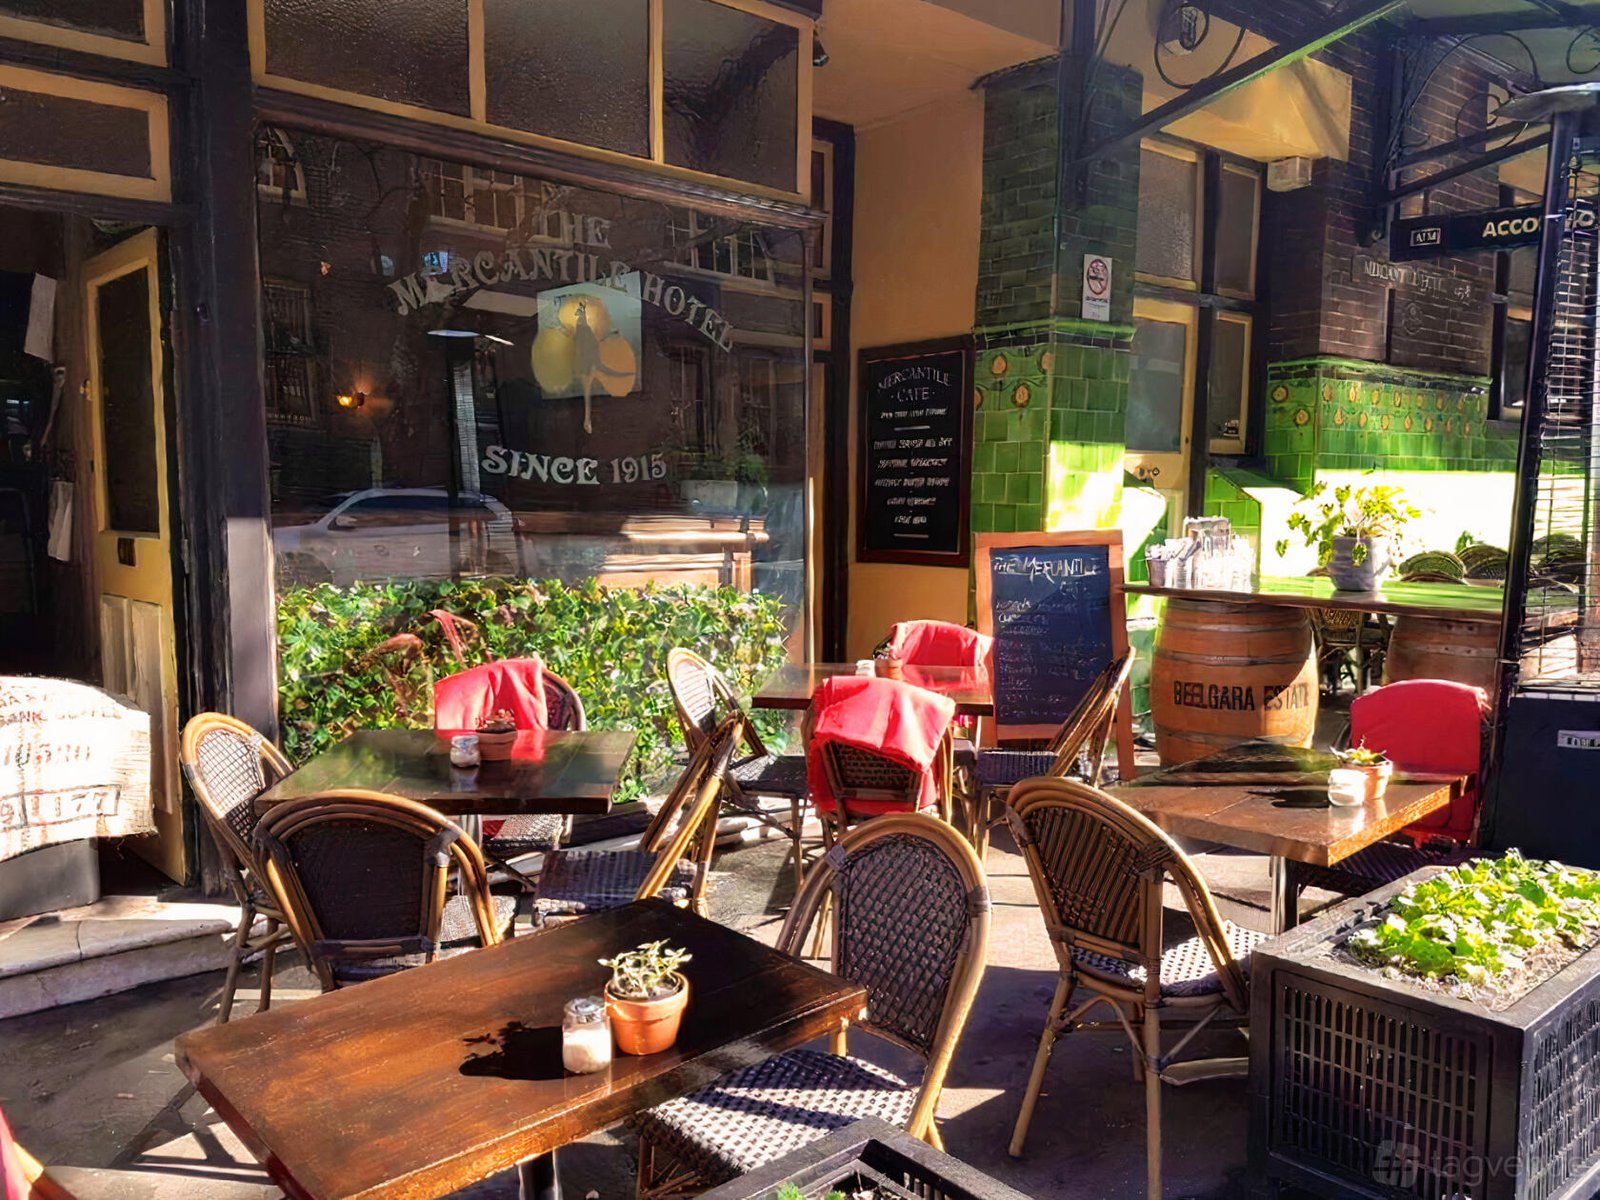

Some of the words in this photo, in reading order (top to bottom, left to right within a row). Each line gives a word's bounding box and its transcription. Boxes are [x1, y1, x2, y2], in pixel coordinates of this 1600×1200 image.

[640, 272, 734, 353] HOTEL
[481, 445, 600, 485] SINCE
[610, 451, 667, 484] 1915
[1173, 680, 1255, 712] BEELGARA
